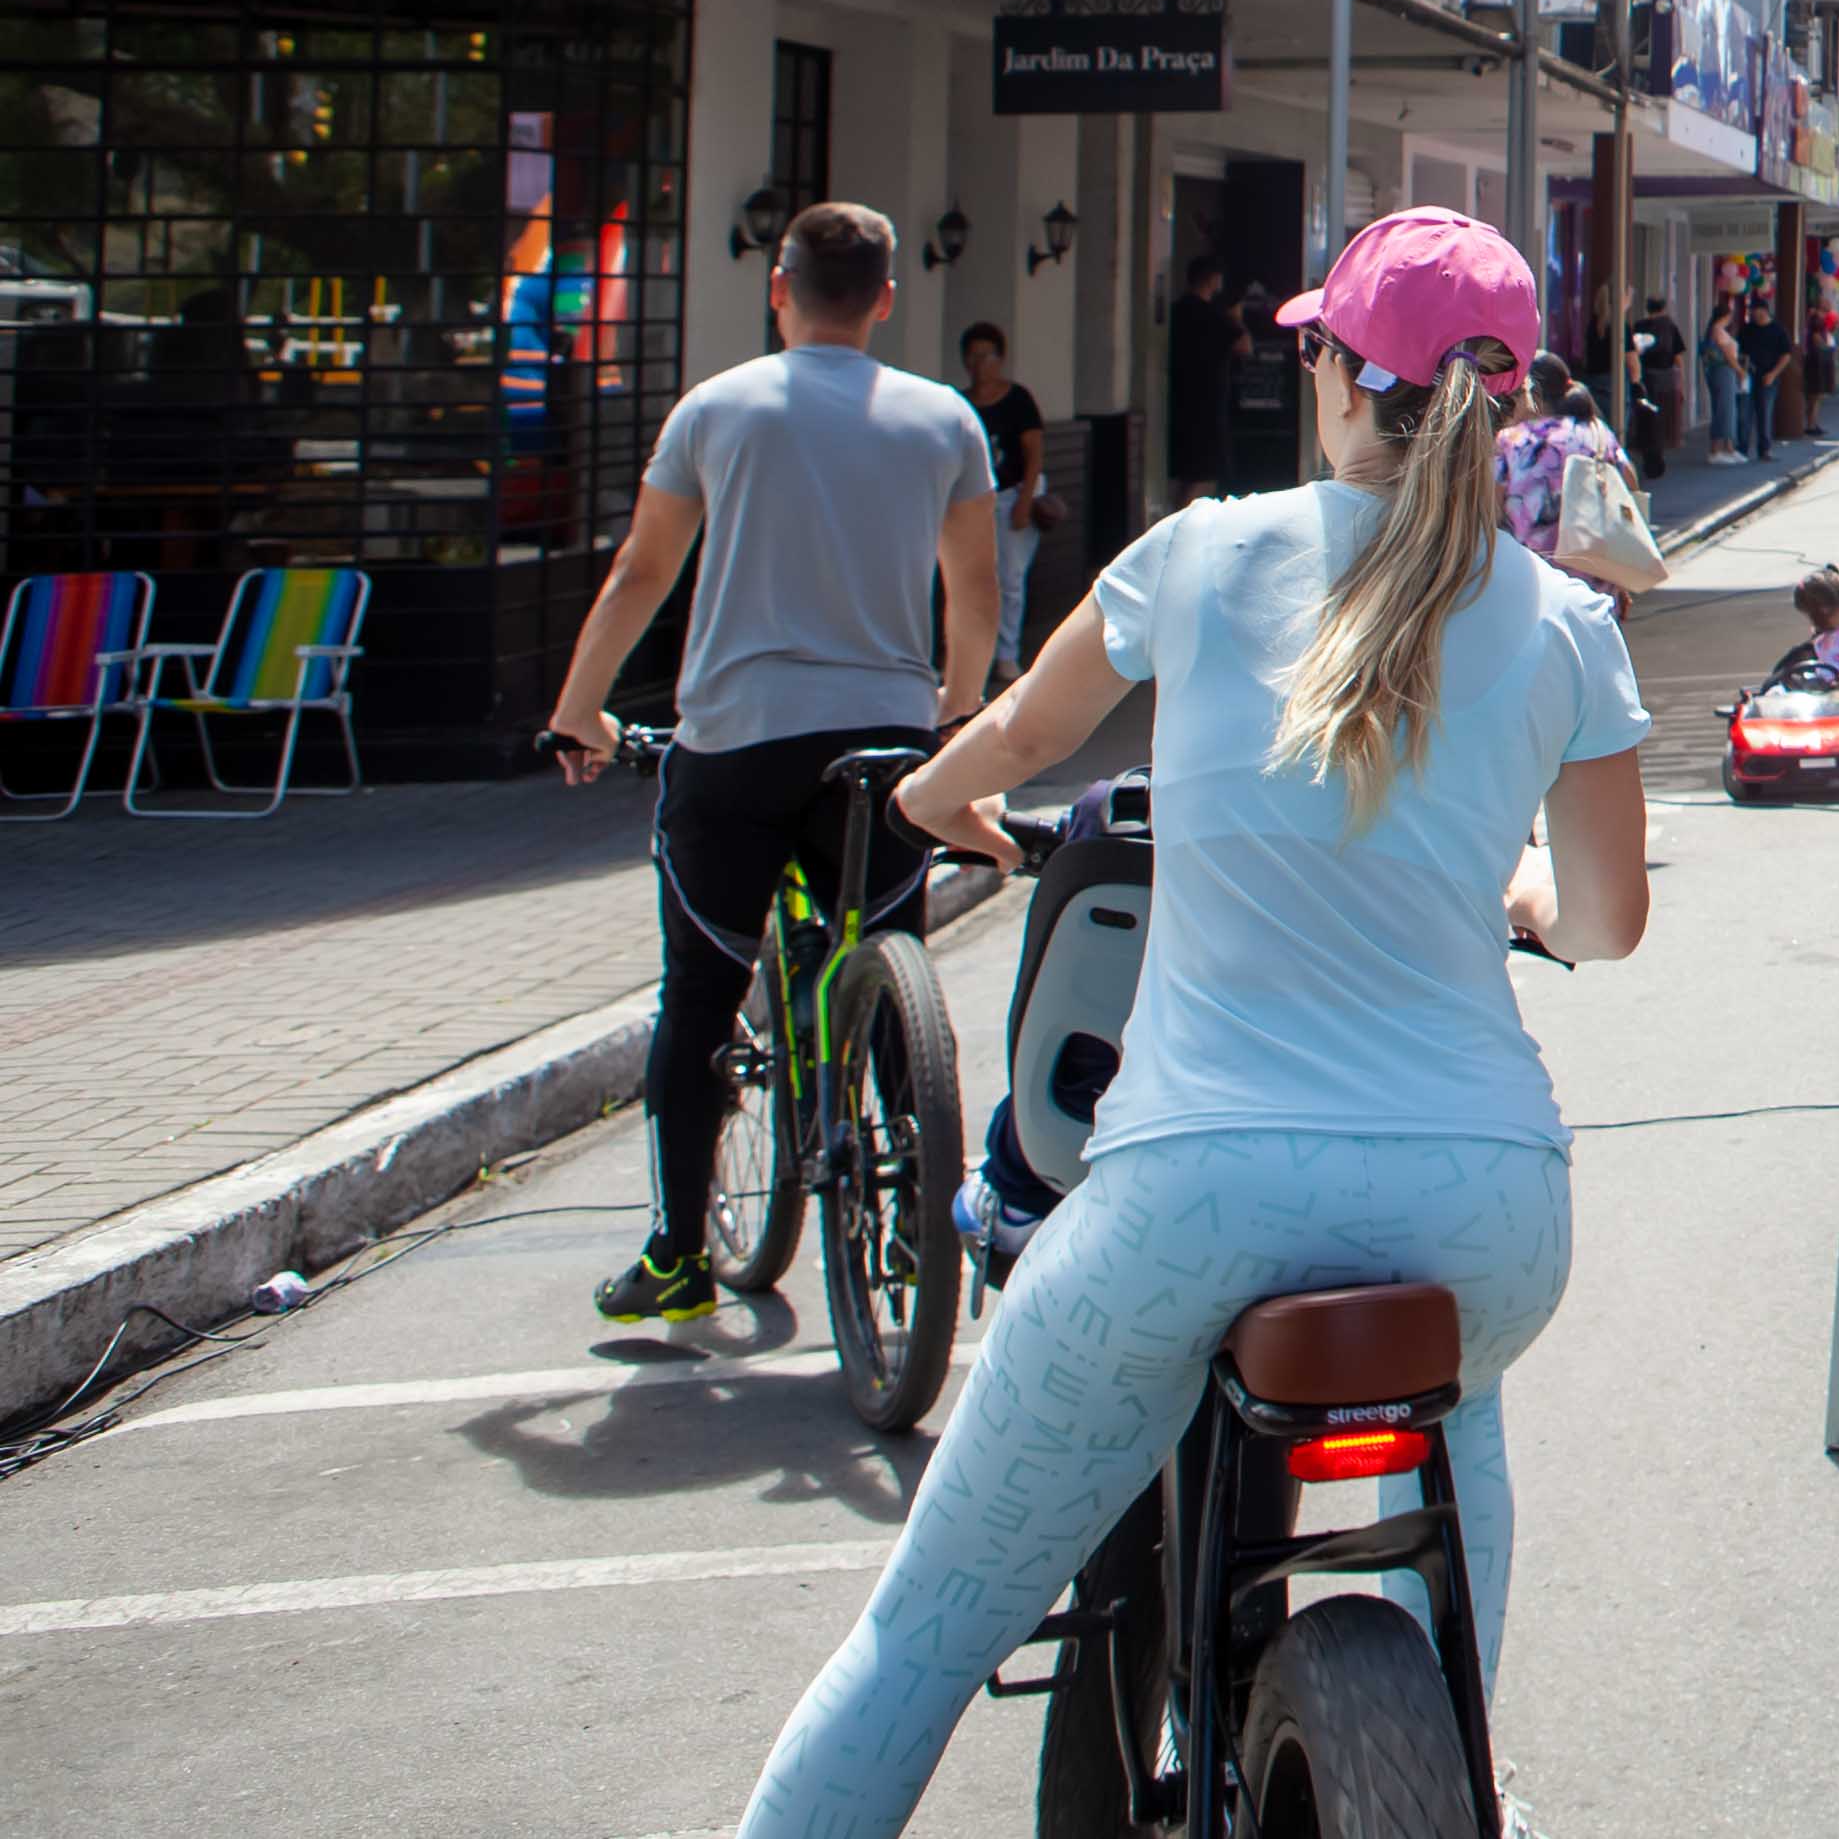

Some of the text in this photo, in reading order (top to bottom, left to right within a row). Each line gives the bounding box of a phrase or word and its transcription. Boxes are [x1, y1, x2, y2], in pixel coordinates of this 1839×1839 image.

[1003, 45, 1216, 75] Jardim Da Praça
[1327, 1403, 1412, 1424] streetgo
